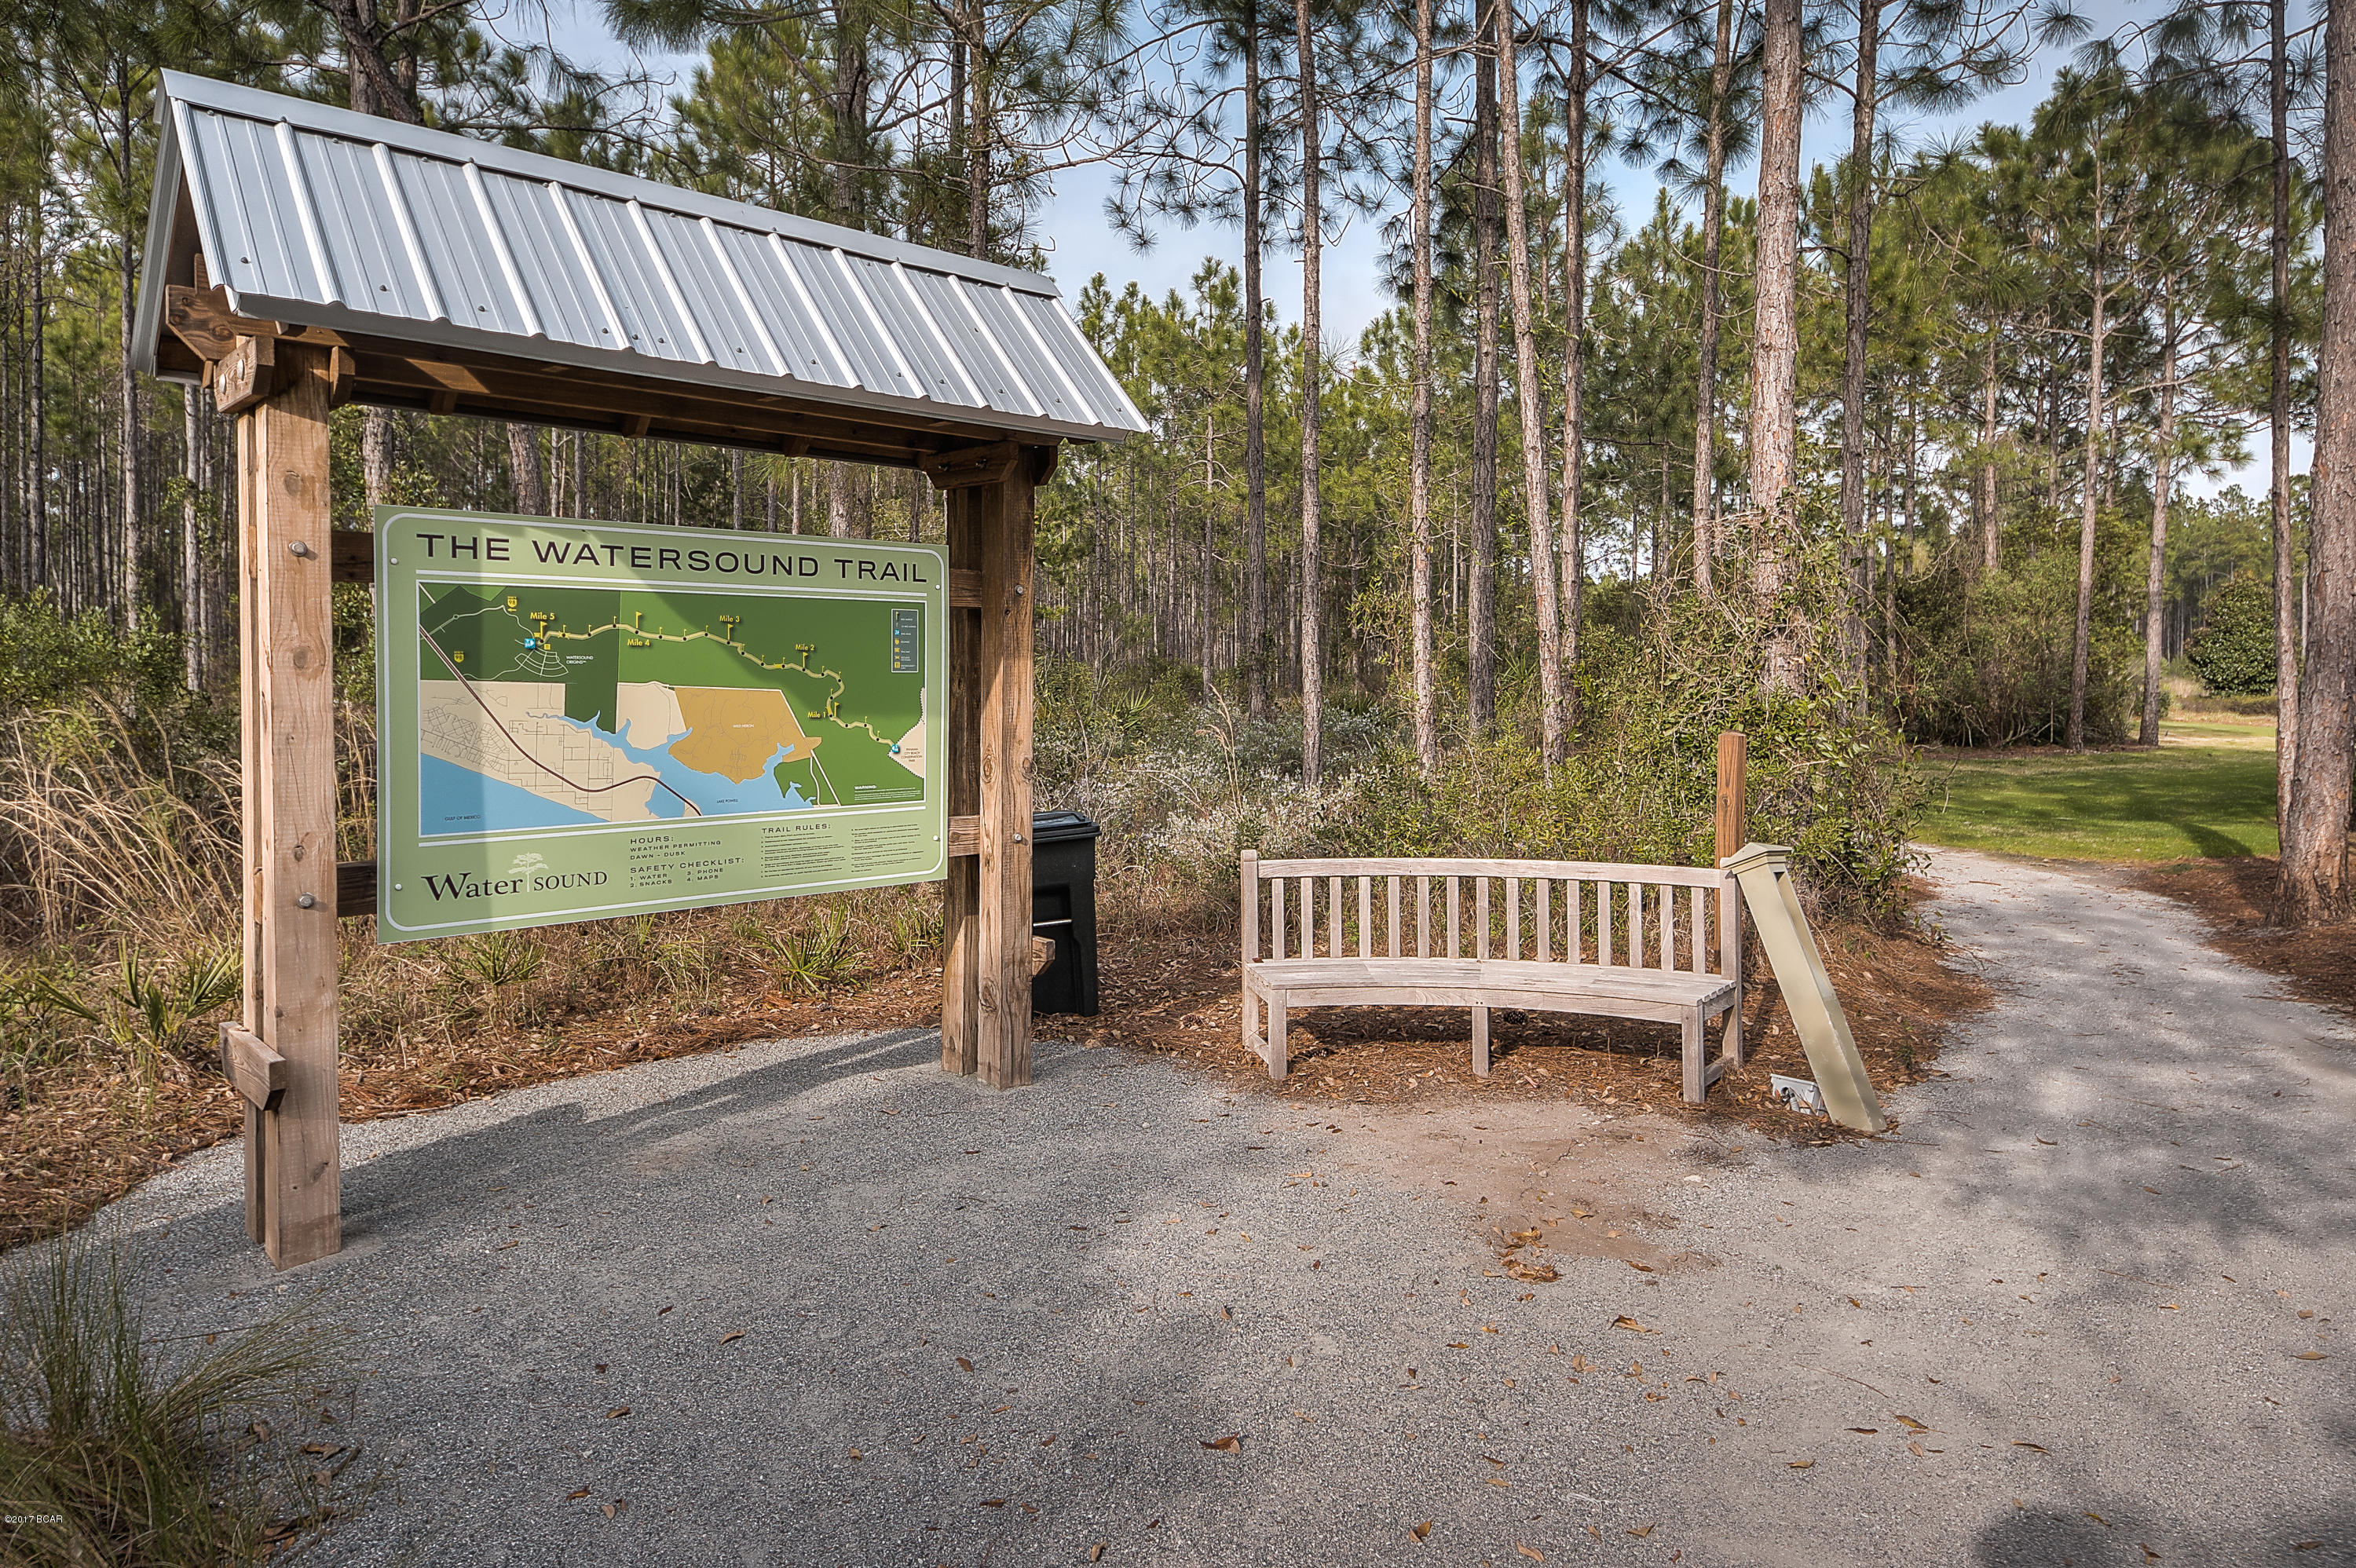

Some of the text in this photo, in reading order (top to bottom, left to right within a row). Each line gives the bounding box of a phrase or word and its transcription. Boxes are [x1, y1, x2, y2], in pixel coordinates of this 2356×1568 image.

[416, 533, 927, 583] THE WATERSOUND TRAIL
[530, 612, 547, 620] Mile
[630, 835, 674, 844] HOURS:
[673, 840, 721, 849] PERMITTING
[630, 857, 744, 873] SAFETY CHECKLIST:
[419, 871, 608, 901] Water SOUND
[639, 879, 672, 887] SNACKS
